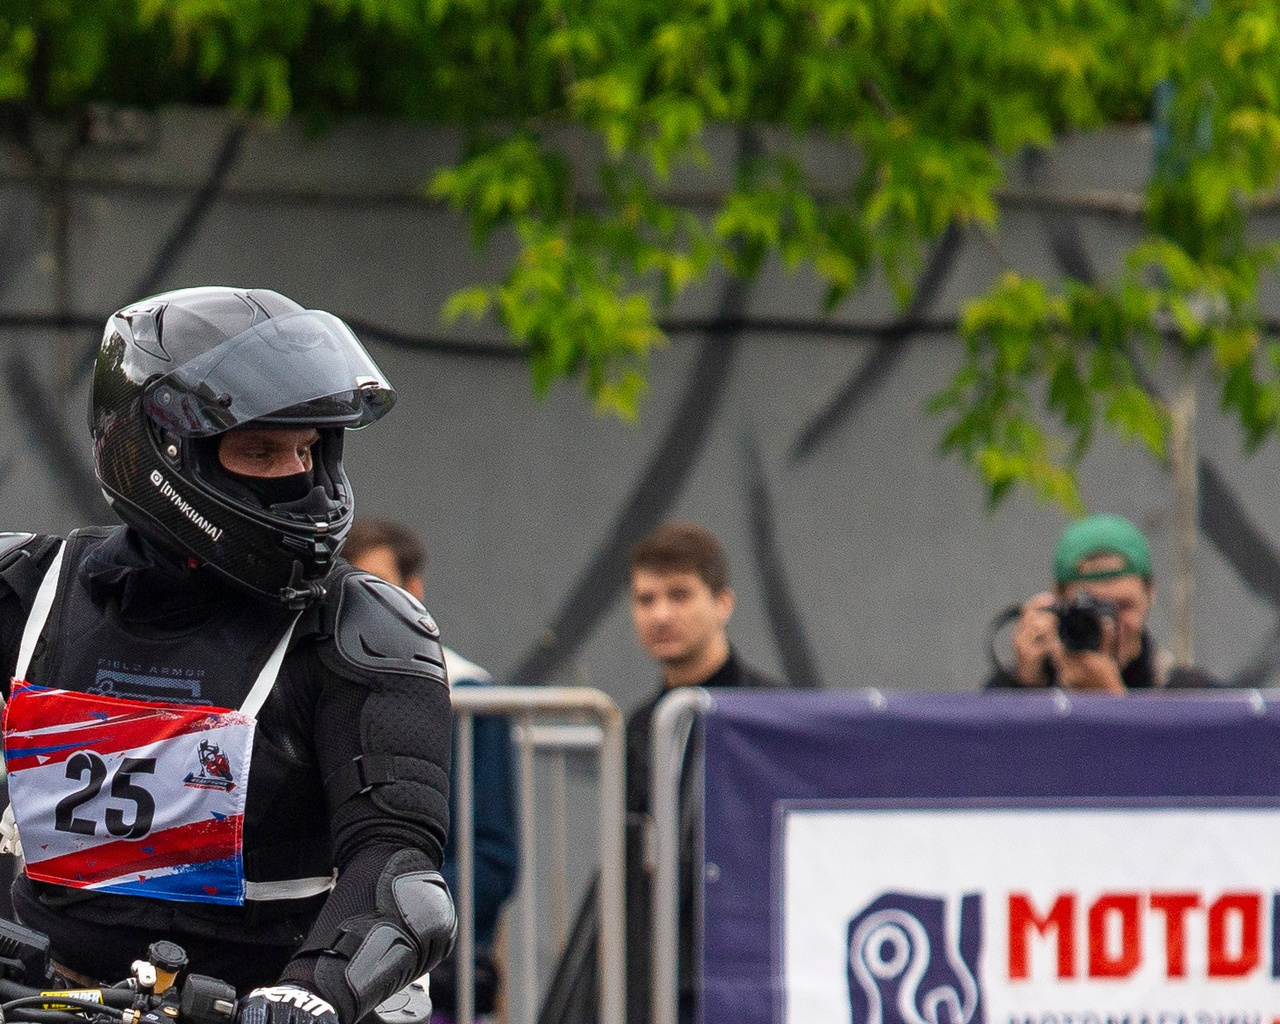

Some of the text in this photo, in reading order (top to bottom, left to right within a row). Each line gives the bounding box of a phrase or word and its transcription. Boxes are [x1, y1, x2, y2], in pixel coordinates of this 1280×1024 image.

[149, 666, 205, 677] ARMOR
[54, 752, 157, 839] 25
[1008, 892, 1280, 979] МОТО
